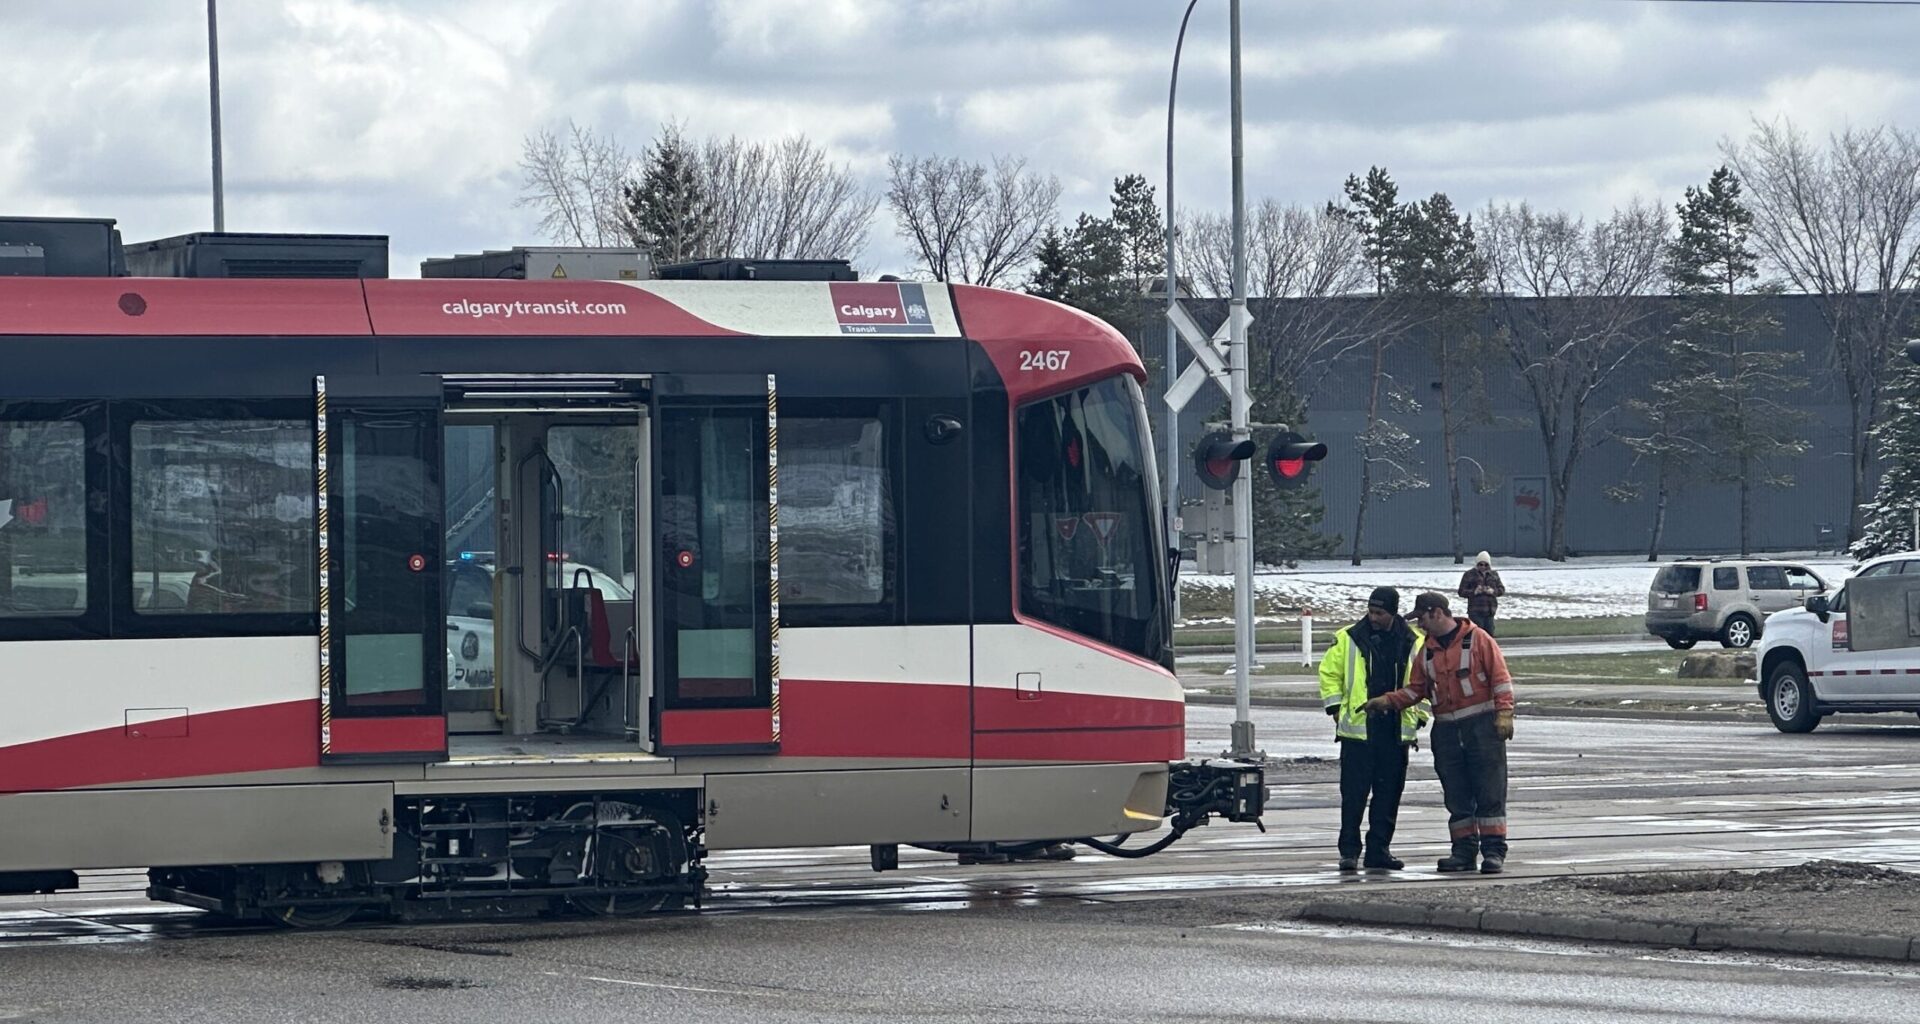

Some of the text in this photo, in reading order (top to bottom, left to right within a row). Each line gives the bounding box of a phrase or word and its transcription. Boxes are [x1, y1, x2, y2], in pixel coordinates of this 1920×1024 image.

[442, 299, 627, 318] calgarytransit.com
[841, 304, 897, 319] Calgary
[846, 325, 877, 333] Transit
[1019, 350, 1071, 371] 2467
